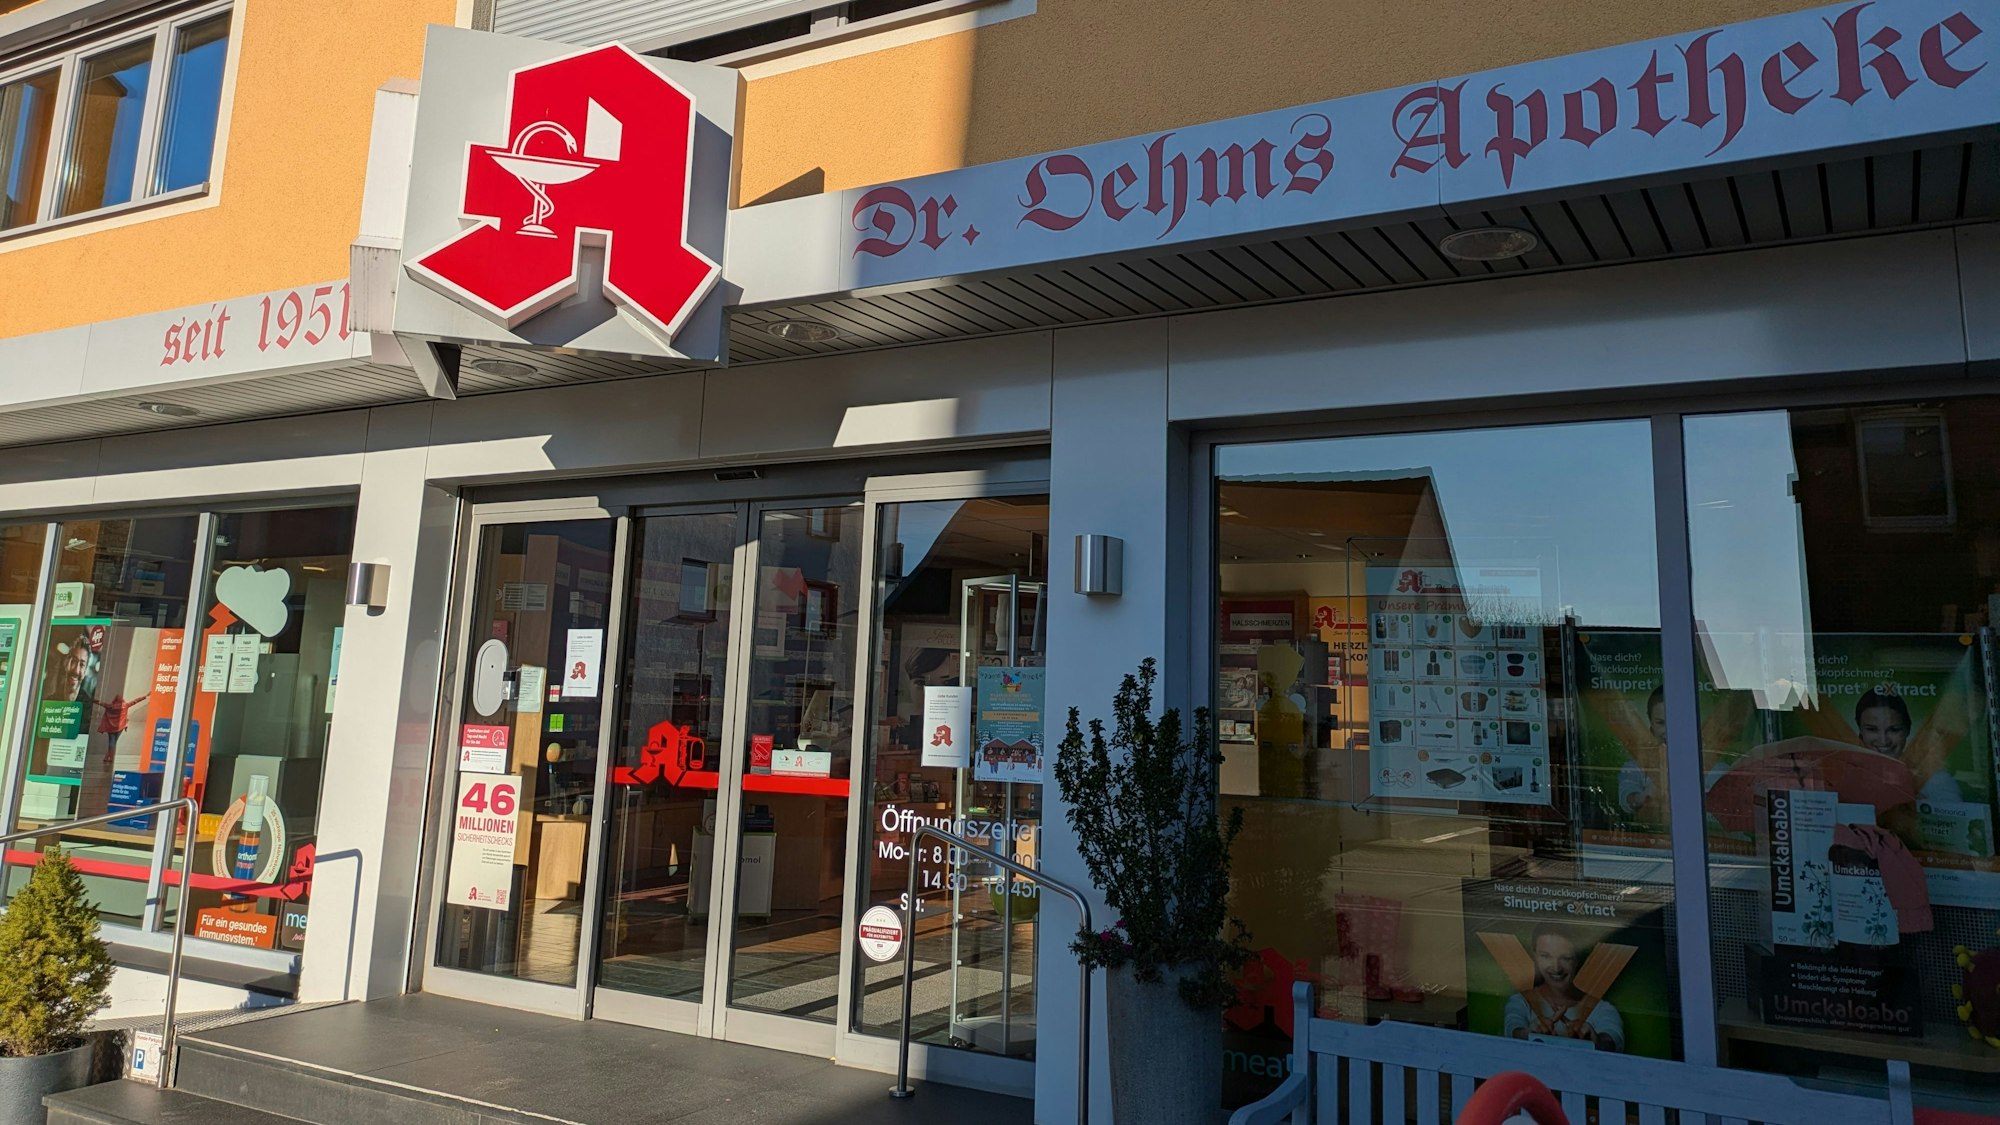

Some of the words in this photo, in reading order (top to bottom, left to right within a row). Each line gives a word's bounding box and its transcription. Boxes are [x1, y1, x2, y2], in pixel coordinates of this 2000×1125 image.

[852, 186, 981, 259] Dr.
[1016, 113, 1335, 240] Oehms
[1389, 1, 1988, 190] Apotheke
[160, 303, 231, 366] seit
[258, 282, 350, 352] 1951
[1378, 601, 1421, 611] Unsere
[1426, 601, 1471, 611] Prämi
[1590, 653, 1612, 662] Nase
[1614, 652, 1641, 662] dicht?
[1818, 655, 1848, 665] dicht?
[158, 663, 173, 672] Mein
[1590, 665, 1664, 676] Druckkopfschm
[155, 683, 174, 694] Regen
[1874, 681, 1936, 696] eXtract
[462, 783, 515, 815] 46
[459, 816, 514, 834] MILLIONEN
[457, 833, 513, 846] SICHERHEITSCHECKS
[879, 842, 927, 863] Mo-r:
[1835, 865, 1880, 876] Umckaloa
[923, 870, 968, 891] 14.30
[1494, 884, 1514, 892] Nase
[1516, 885, 1539, 894] dicht?
[1542, 888, 1625, 902] Druckkopfschmerz?
[1567, 902, 1616, 917] eXtract
[201, 914, 215, 926] Für
[215, 917, 228, 929] ein
[229, 920, 267, 934] gesundes
[285, 912, 308, 929] me
